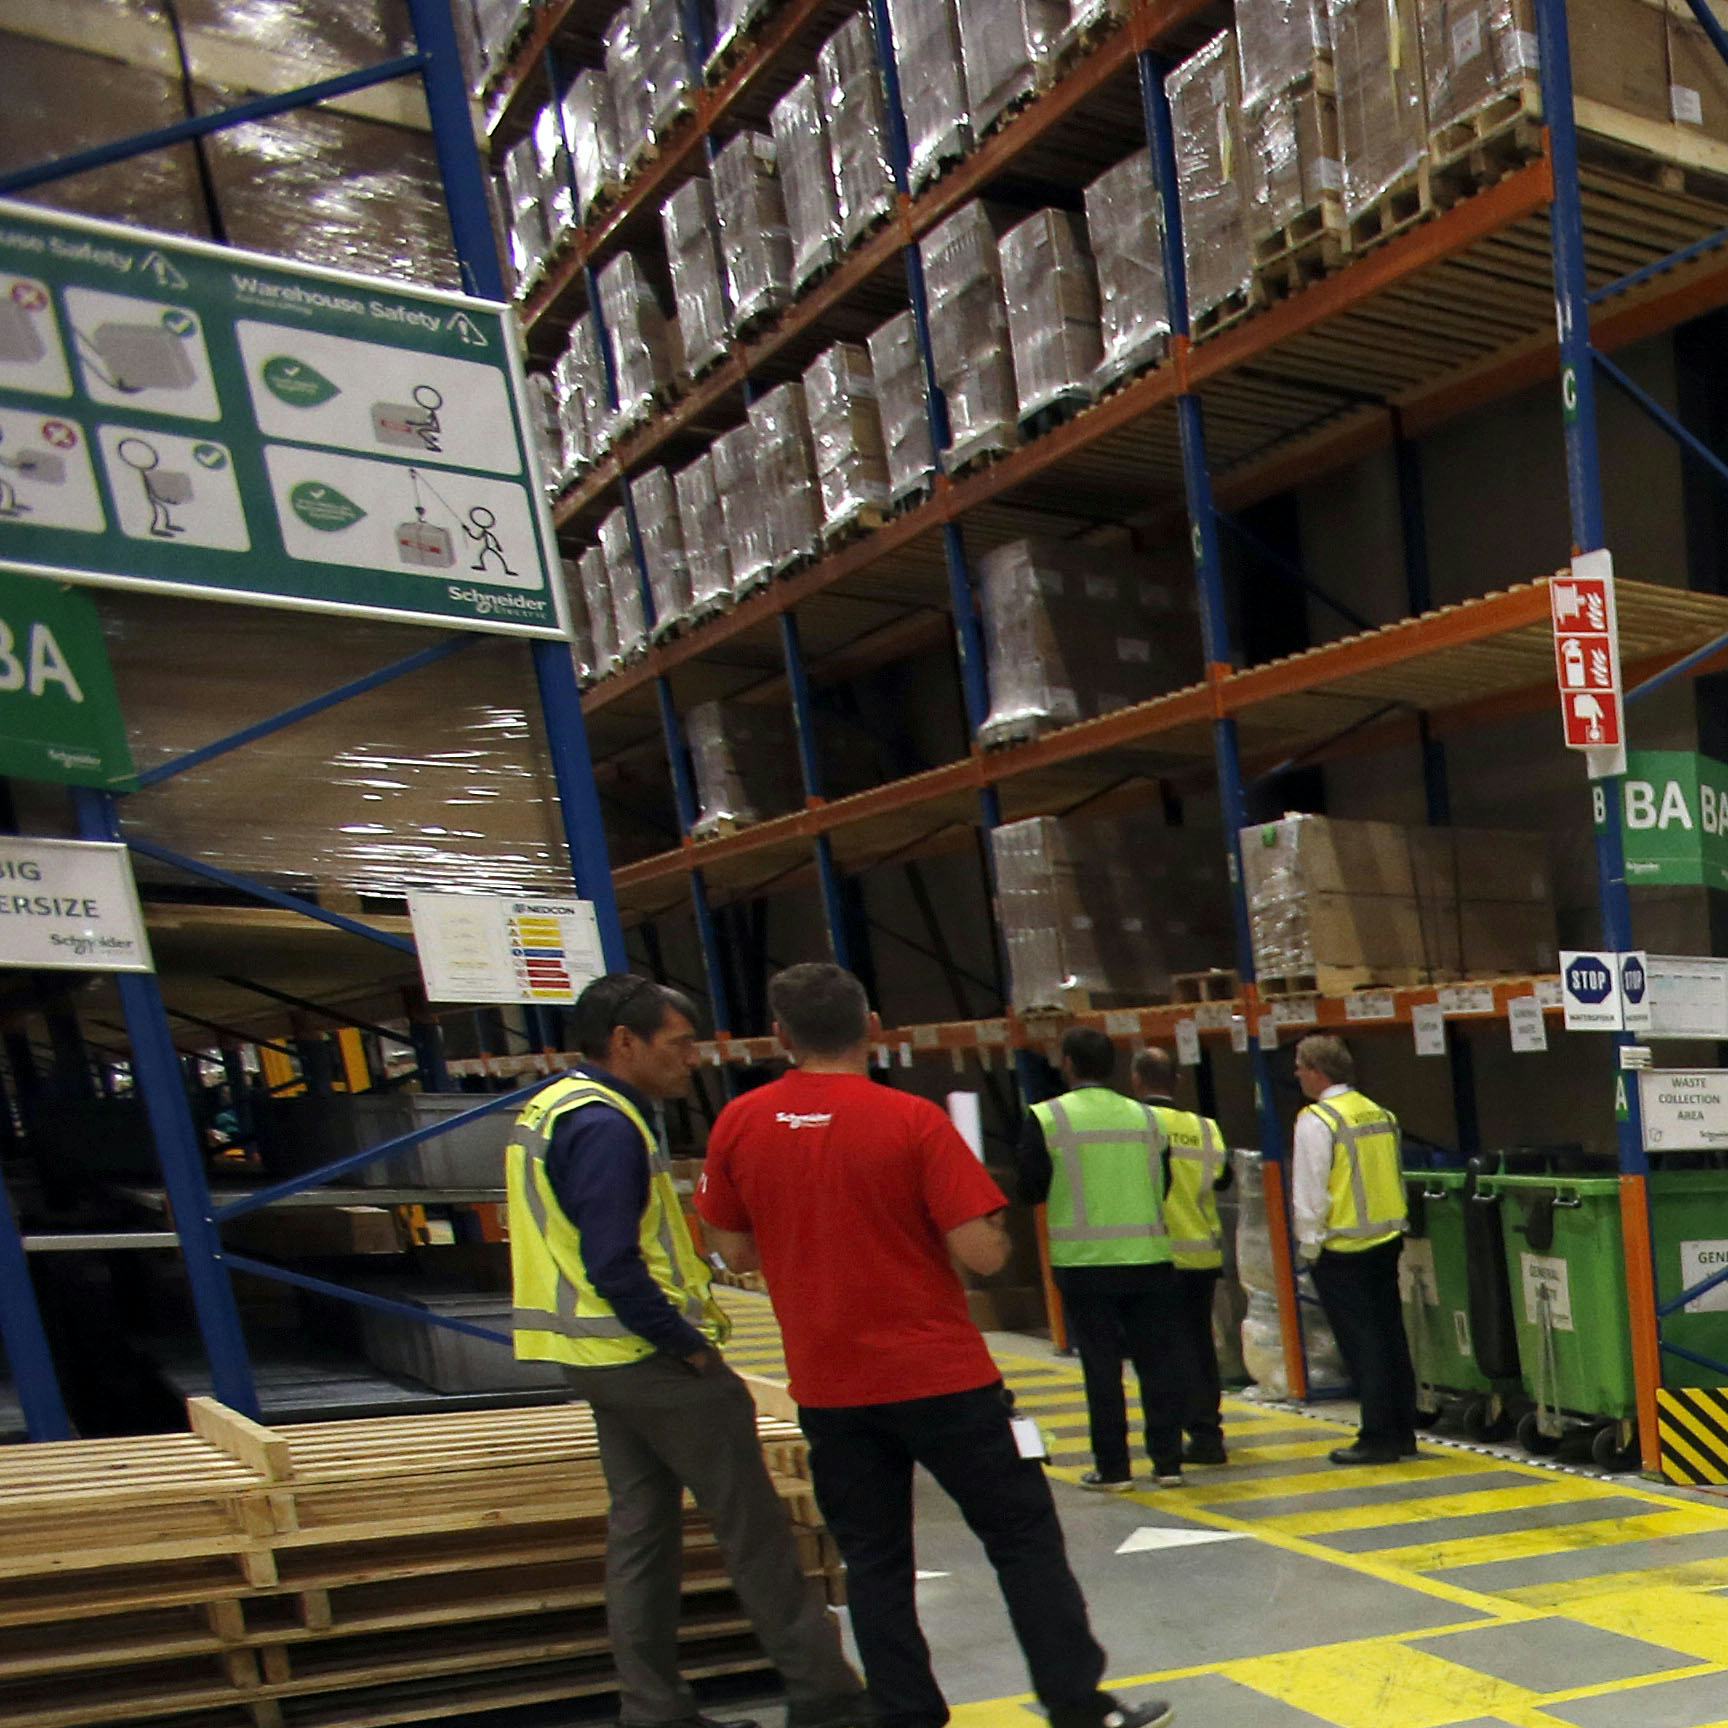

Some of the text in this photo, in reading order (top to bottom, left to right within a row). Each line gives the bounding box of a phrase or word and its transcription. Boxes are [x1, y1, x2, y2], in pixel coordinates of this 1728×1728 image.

[230, 273, 364, 315] Warehouse
[369, 301, 441, 332] Safety
[448, 585, 546, 611] Schneider
[1624, 781, 1693, 830] BA
[527, 905, 575, 915] NEDCON
[1571, 970, 1606, 991] STOP
[1615, 1075, 1628, 1111] A
[1671, 1077, 1707, 1089] WASTE
[1658, 1094, 1720, 1104] COLLECTION
[1677, 1110, 1705, 1120] AREA
